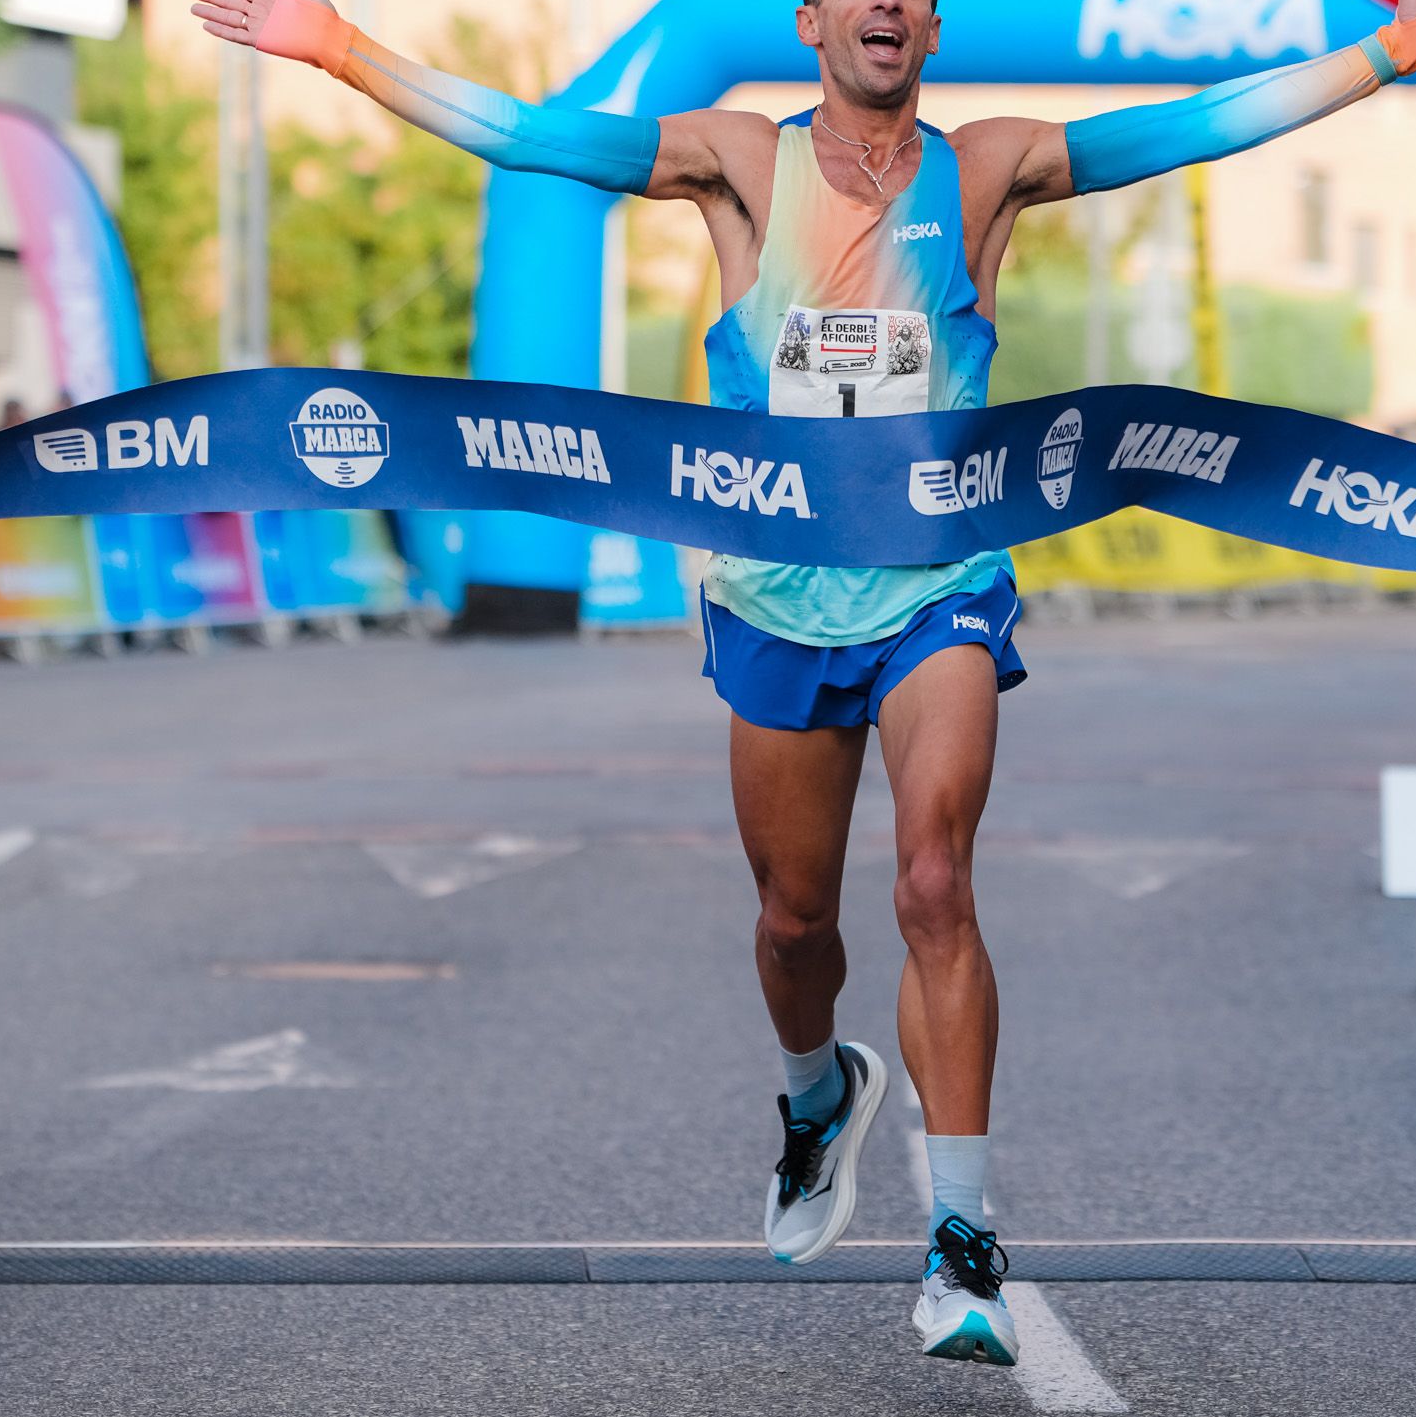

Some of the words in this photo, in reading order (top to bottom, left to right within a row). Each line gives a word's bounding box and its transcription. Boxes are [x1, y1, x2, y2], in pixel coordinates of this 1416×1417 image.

[893, 222, 942, 244] HOKA
[821, 324, 833, 332] EL
[836, 324, 866, 333] DERBI
[821, 333, 877, 343] AFICIONES
[309, 403, 367, 421] RADIO
[106, 415, 208, 469] BM
[303, 427, 381, 453] MARCA
[1049, 421, 1079, 441] RADIO
[457, 417, 611, 483] MARCA
[1041, 444, 1076, 476] MARCA
[1108, 423, 1239, 483] MARCA
[671, 443, 811, 519] HOKA
[959, 446, 1008, 509] BM
[953, 614, 990, 637] HOKA
